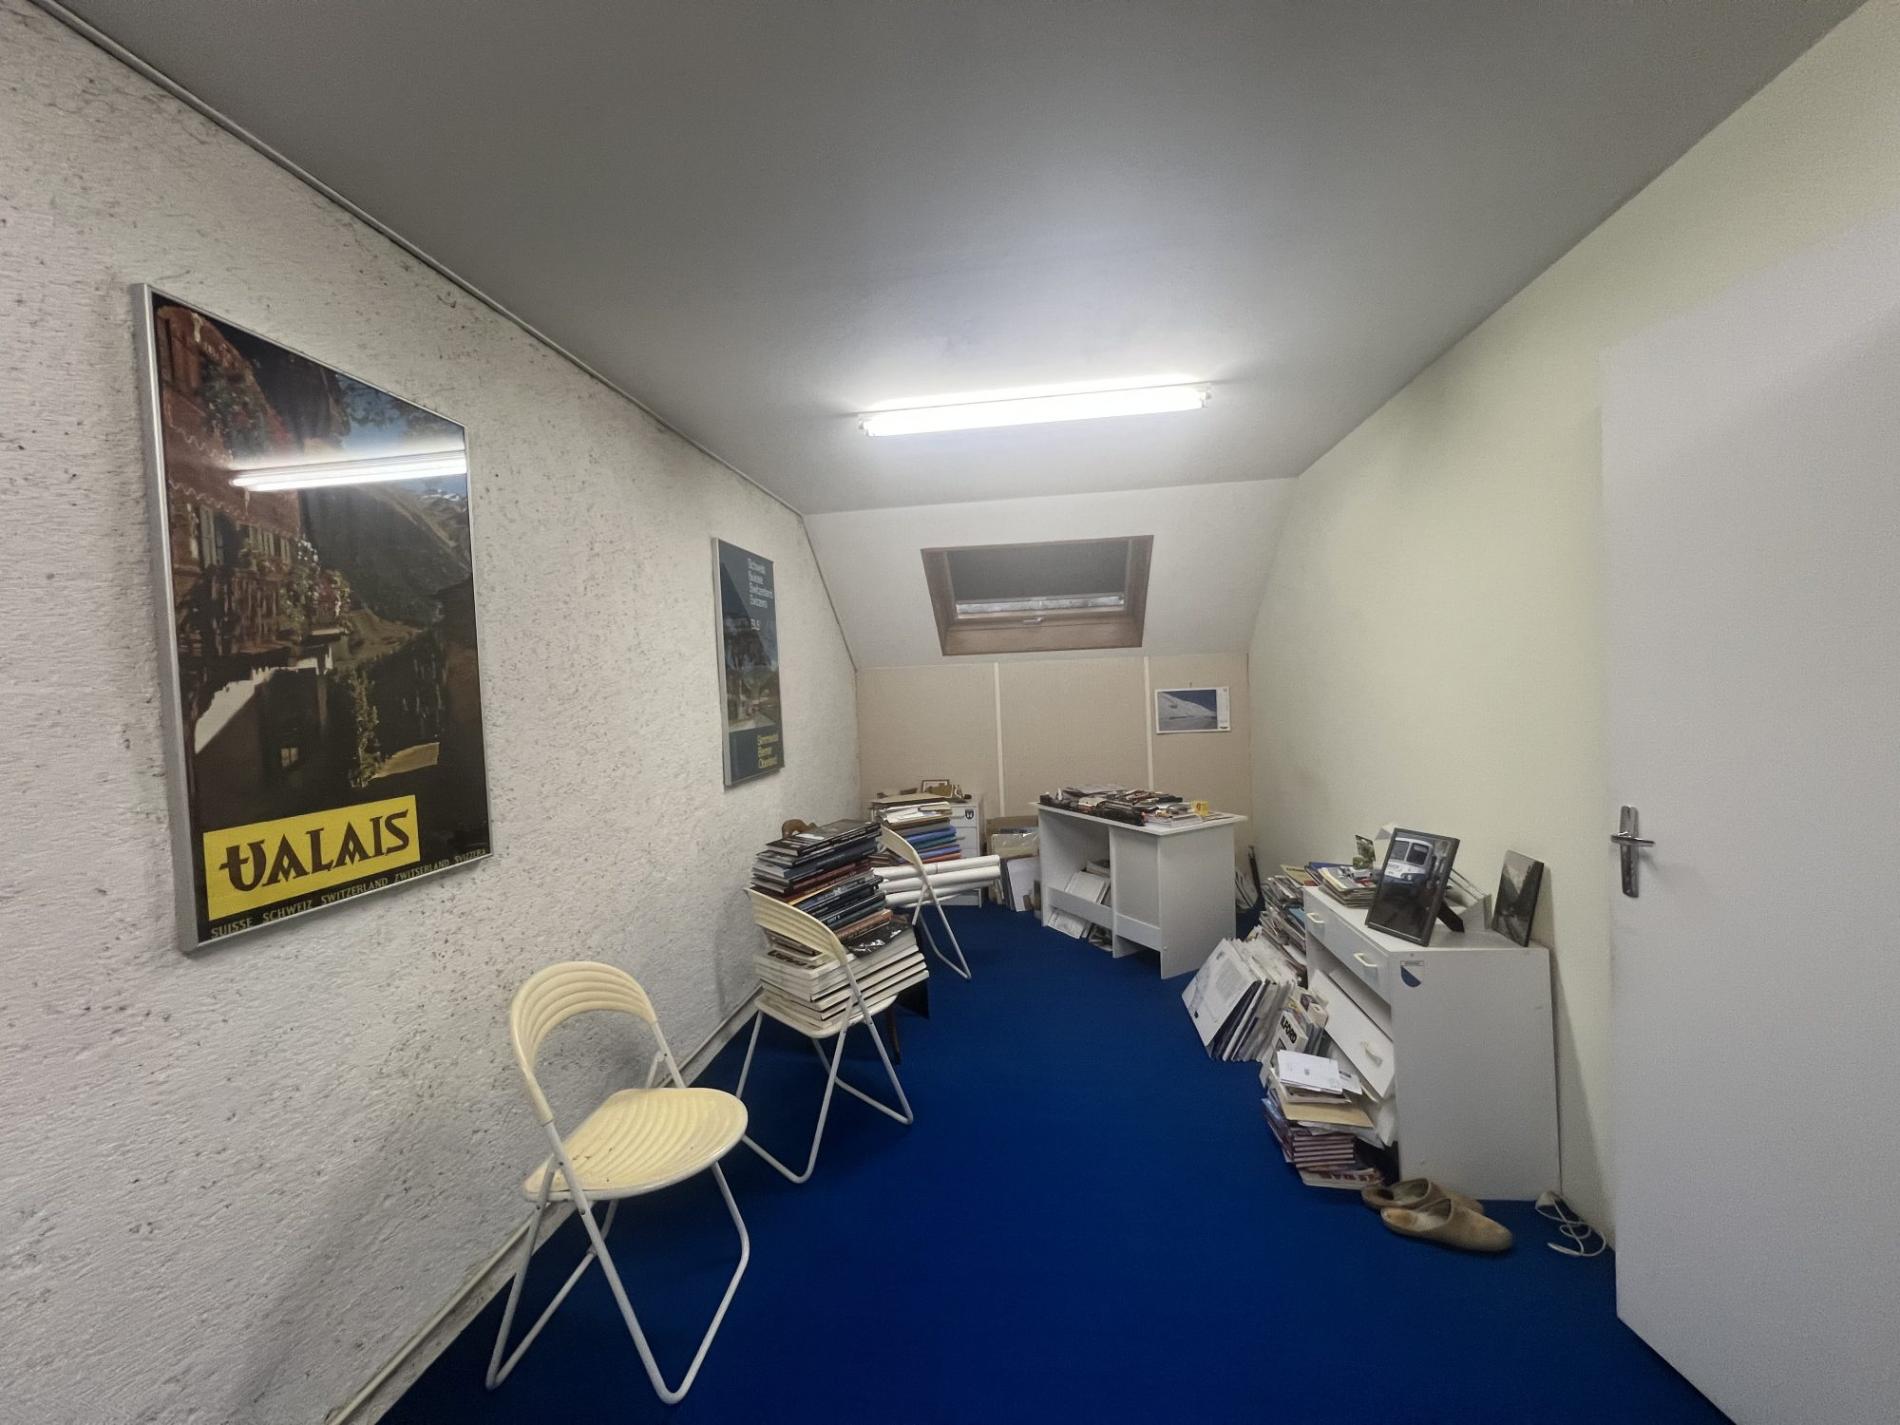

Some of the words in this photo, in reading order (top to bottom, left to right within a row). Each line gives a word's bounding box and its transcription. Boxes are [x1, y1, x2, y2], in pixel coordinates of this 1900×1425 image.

[210, 916, 254, 939] SUISSE
[262, 899, 313, 923] SCHWEIZ
[321, 876, 389, 905] SWITZERLAND
